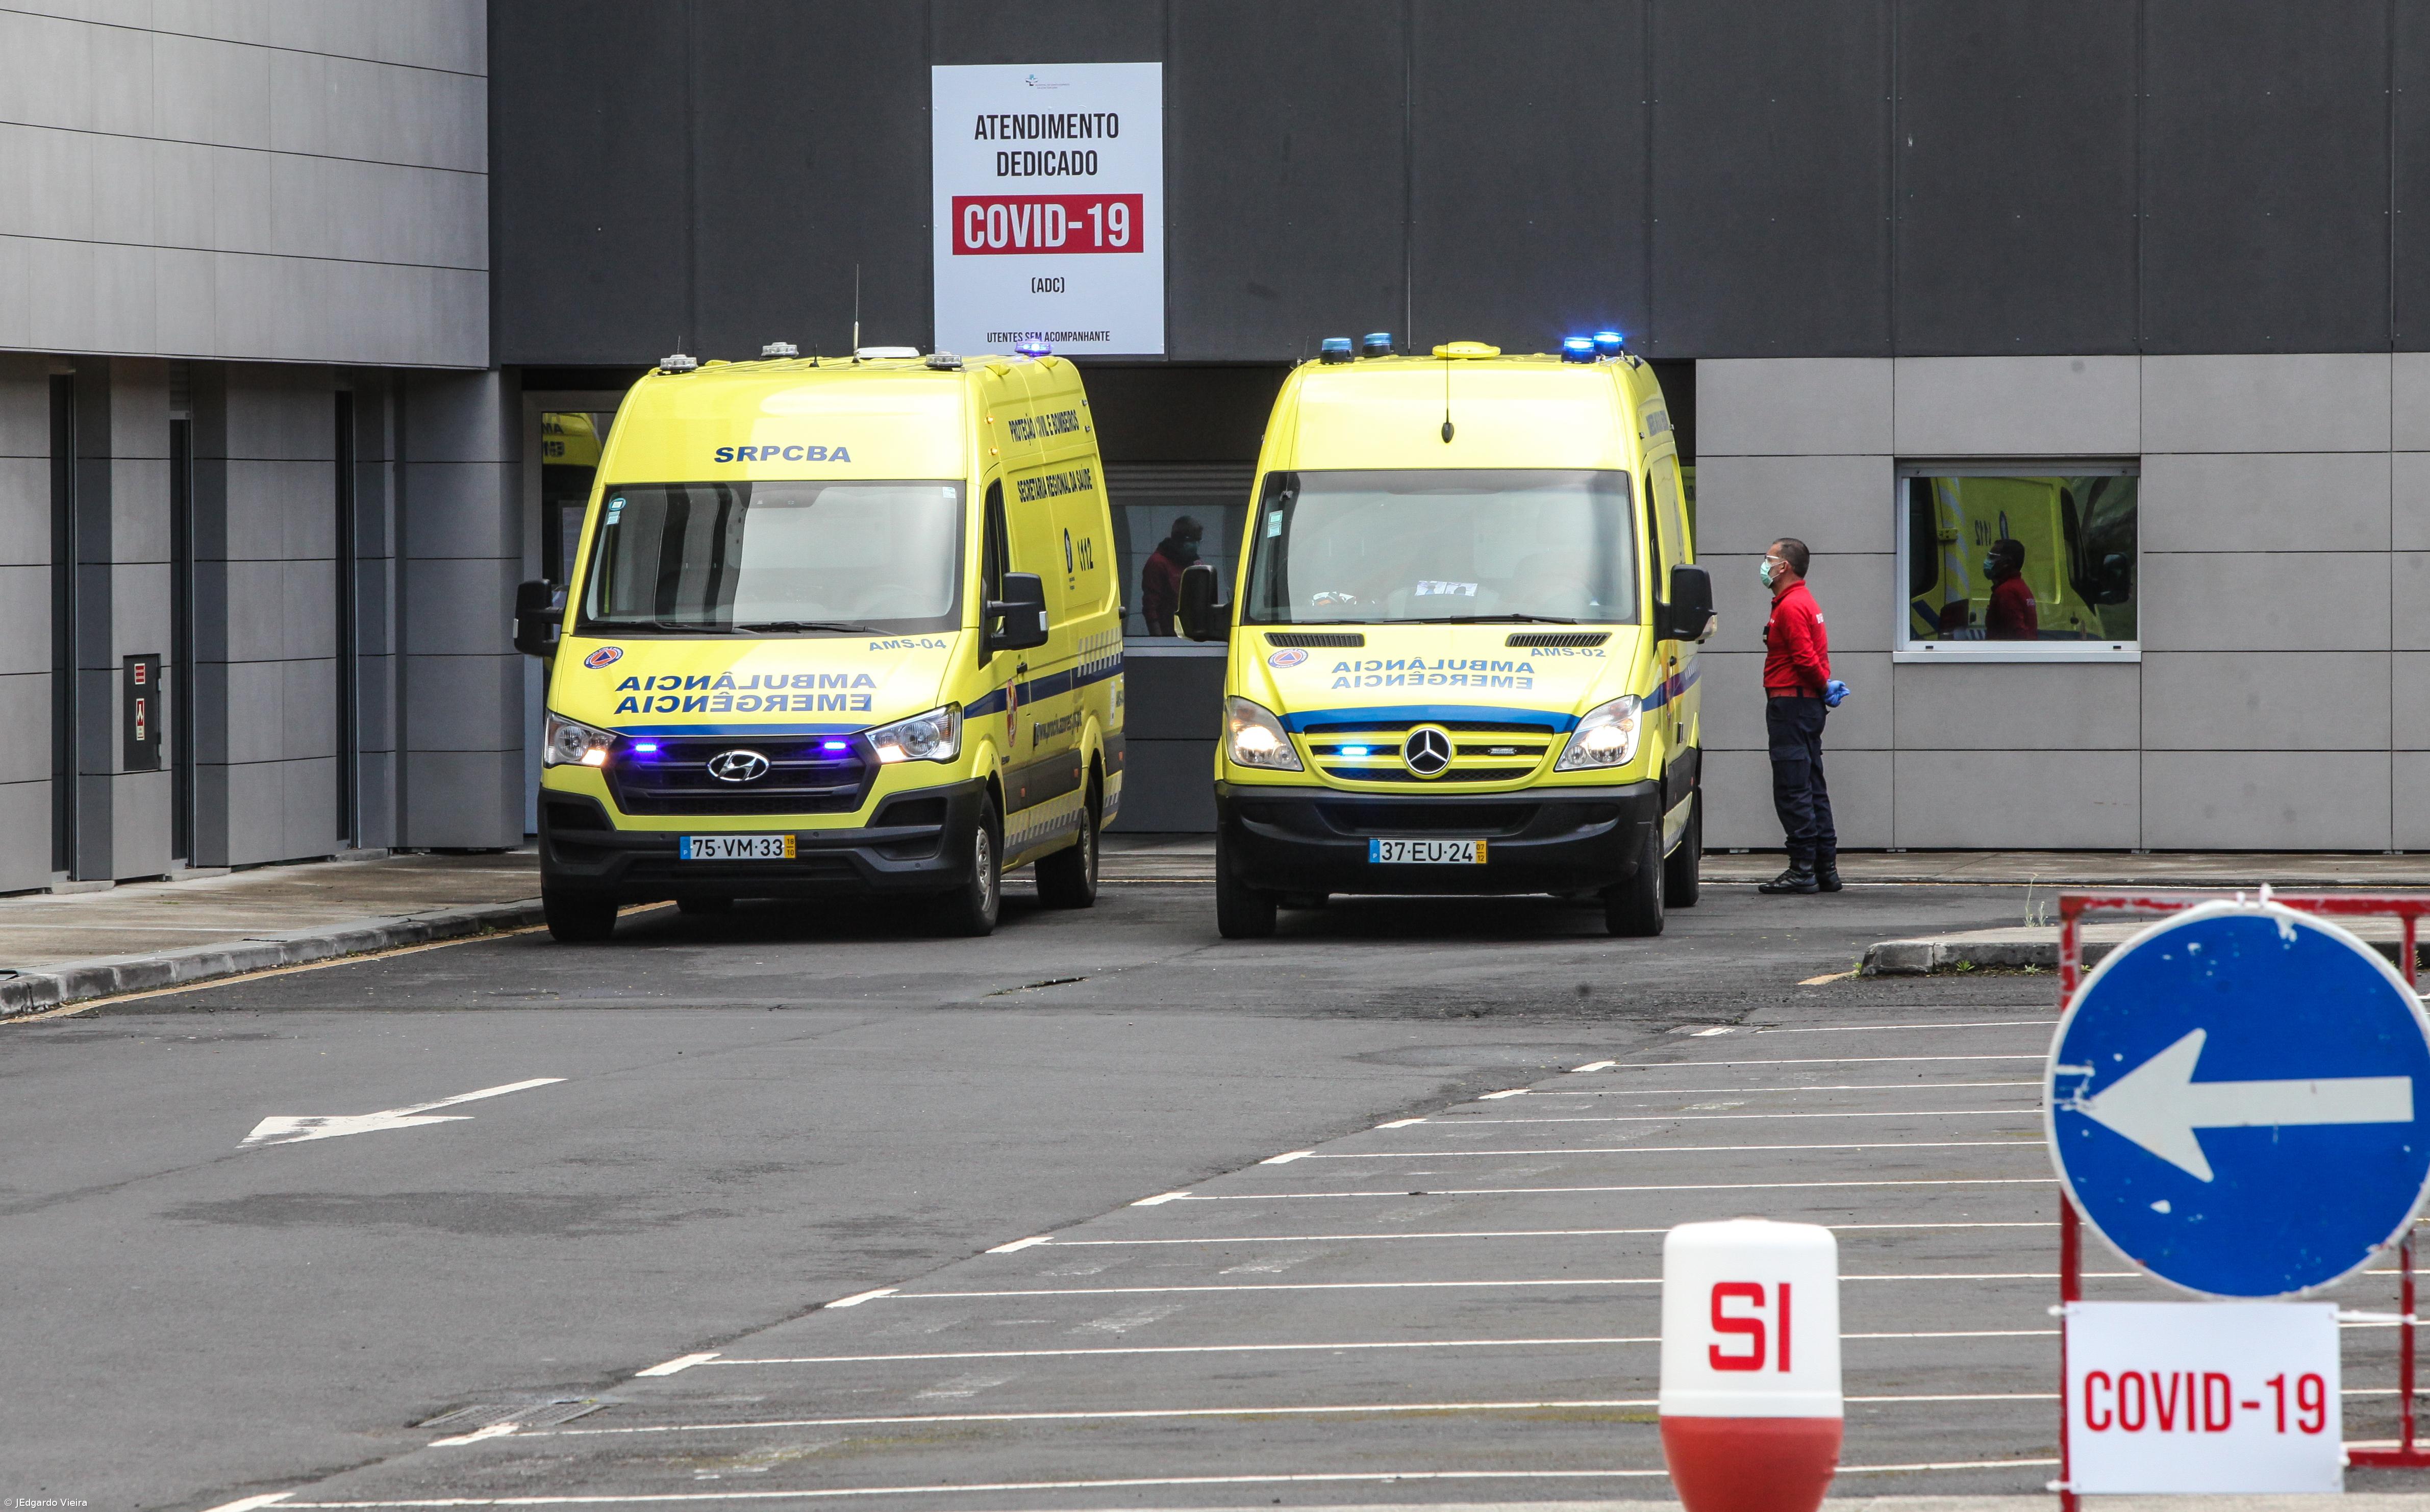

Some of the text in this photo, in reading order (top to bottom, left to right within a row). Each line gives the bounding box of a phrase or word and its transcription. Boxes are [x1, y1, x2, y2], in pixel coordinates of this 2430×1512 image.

[974, 113, 1119, 140] ATENDIMENTO
[997, 150, 1097, 177] DEDICADO
[964, 203, 1130, 248] COVID-19
[1032, 277, 1065, 293] (ADC)
[987, 332, 1023, 343] UTENTES
[1045, 331, 1110, 342] ACOMPANHANTE
[714, 445, 851, 463] SRPCBA
[869, 639, 947, 652] AMS-04
[1531, 647, 1607, 658] AMS-02
[1708, 1281, 1792, 1373] SI
[2084, 1370, 2326, 1434] COVID-19
